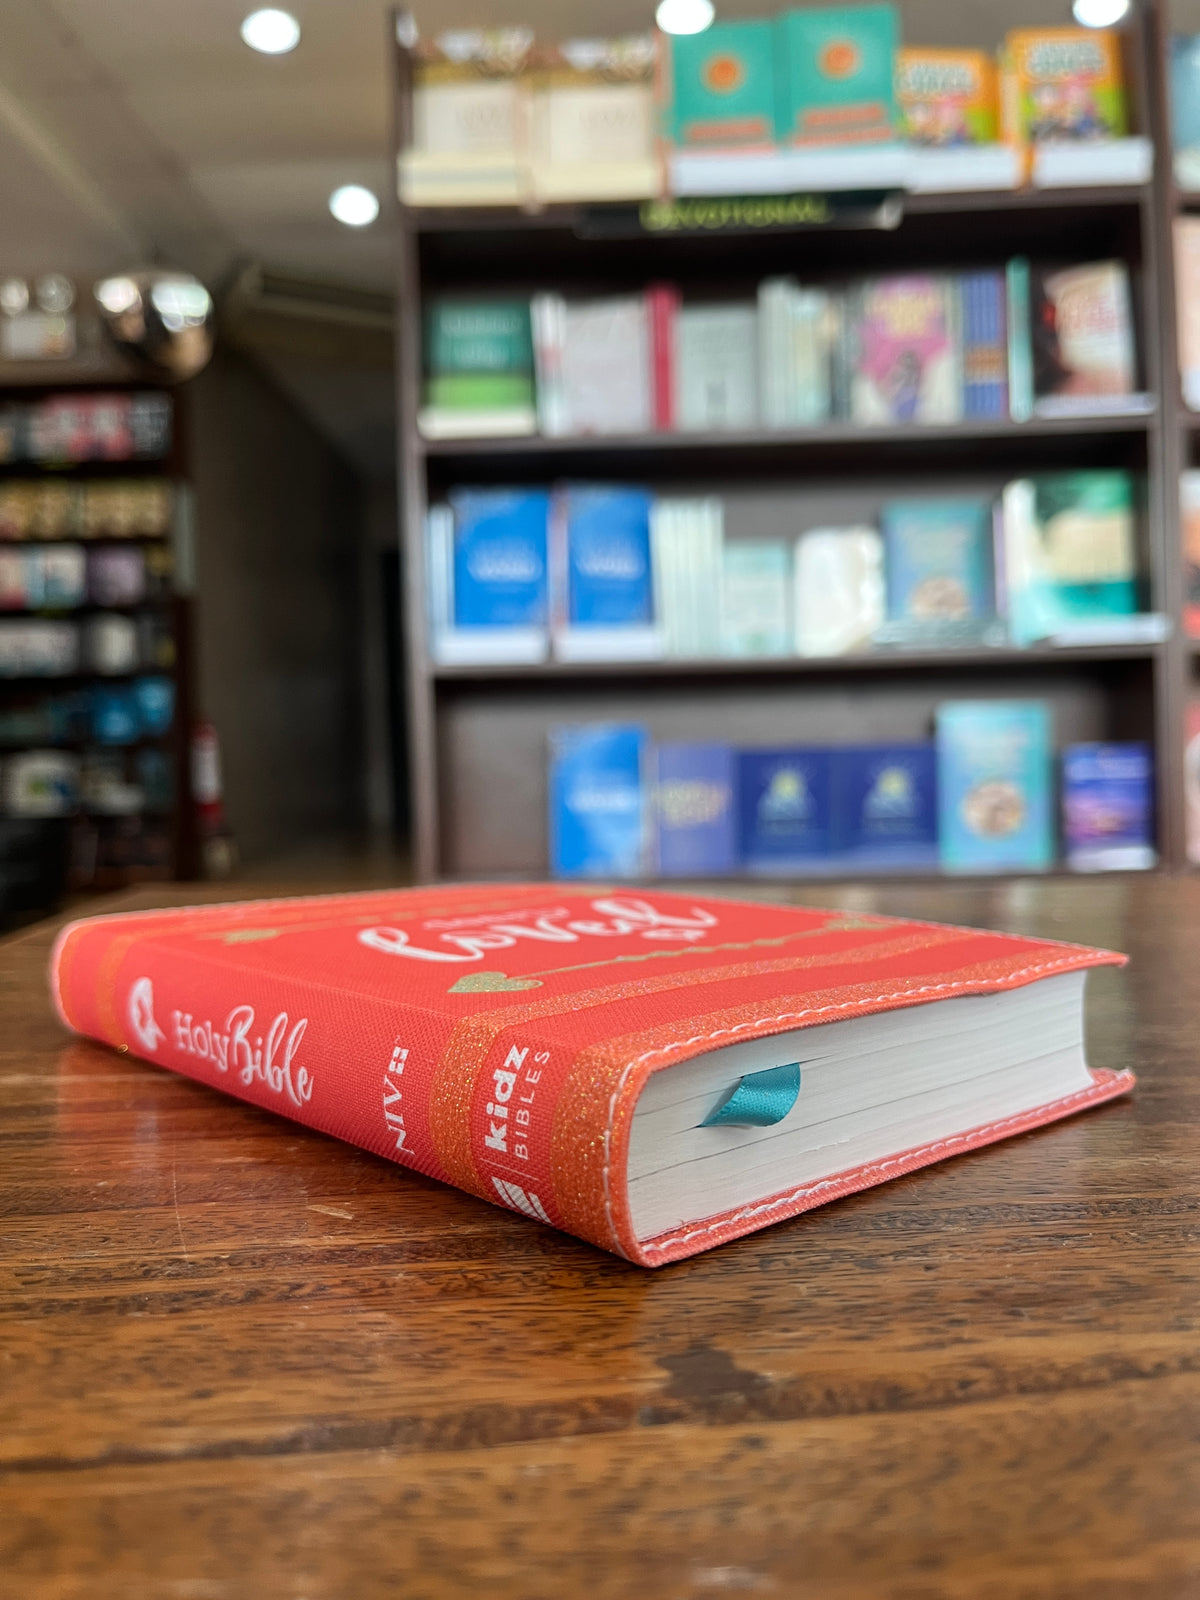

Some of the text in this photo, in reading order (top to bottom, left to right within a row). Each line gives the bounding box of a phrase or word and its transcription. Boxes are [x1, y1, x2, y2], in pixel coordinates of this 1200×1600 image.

[172, 1005, 316, 1107] Holy Bible
[485, 1043, 530, 1153] kidz
[514, 1050, 552, 1160] BIBLES
